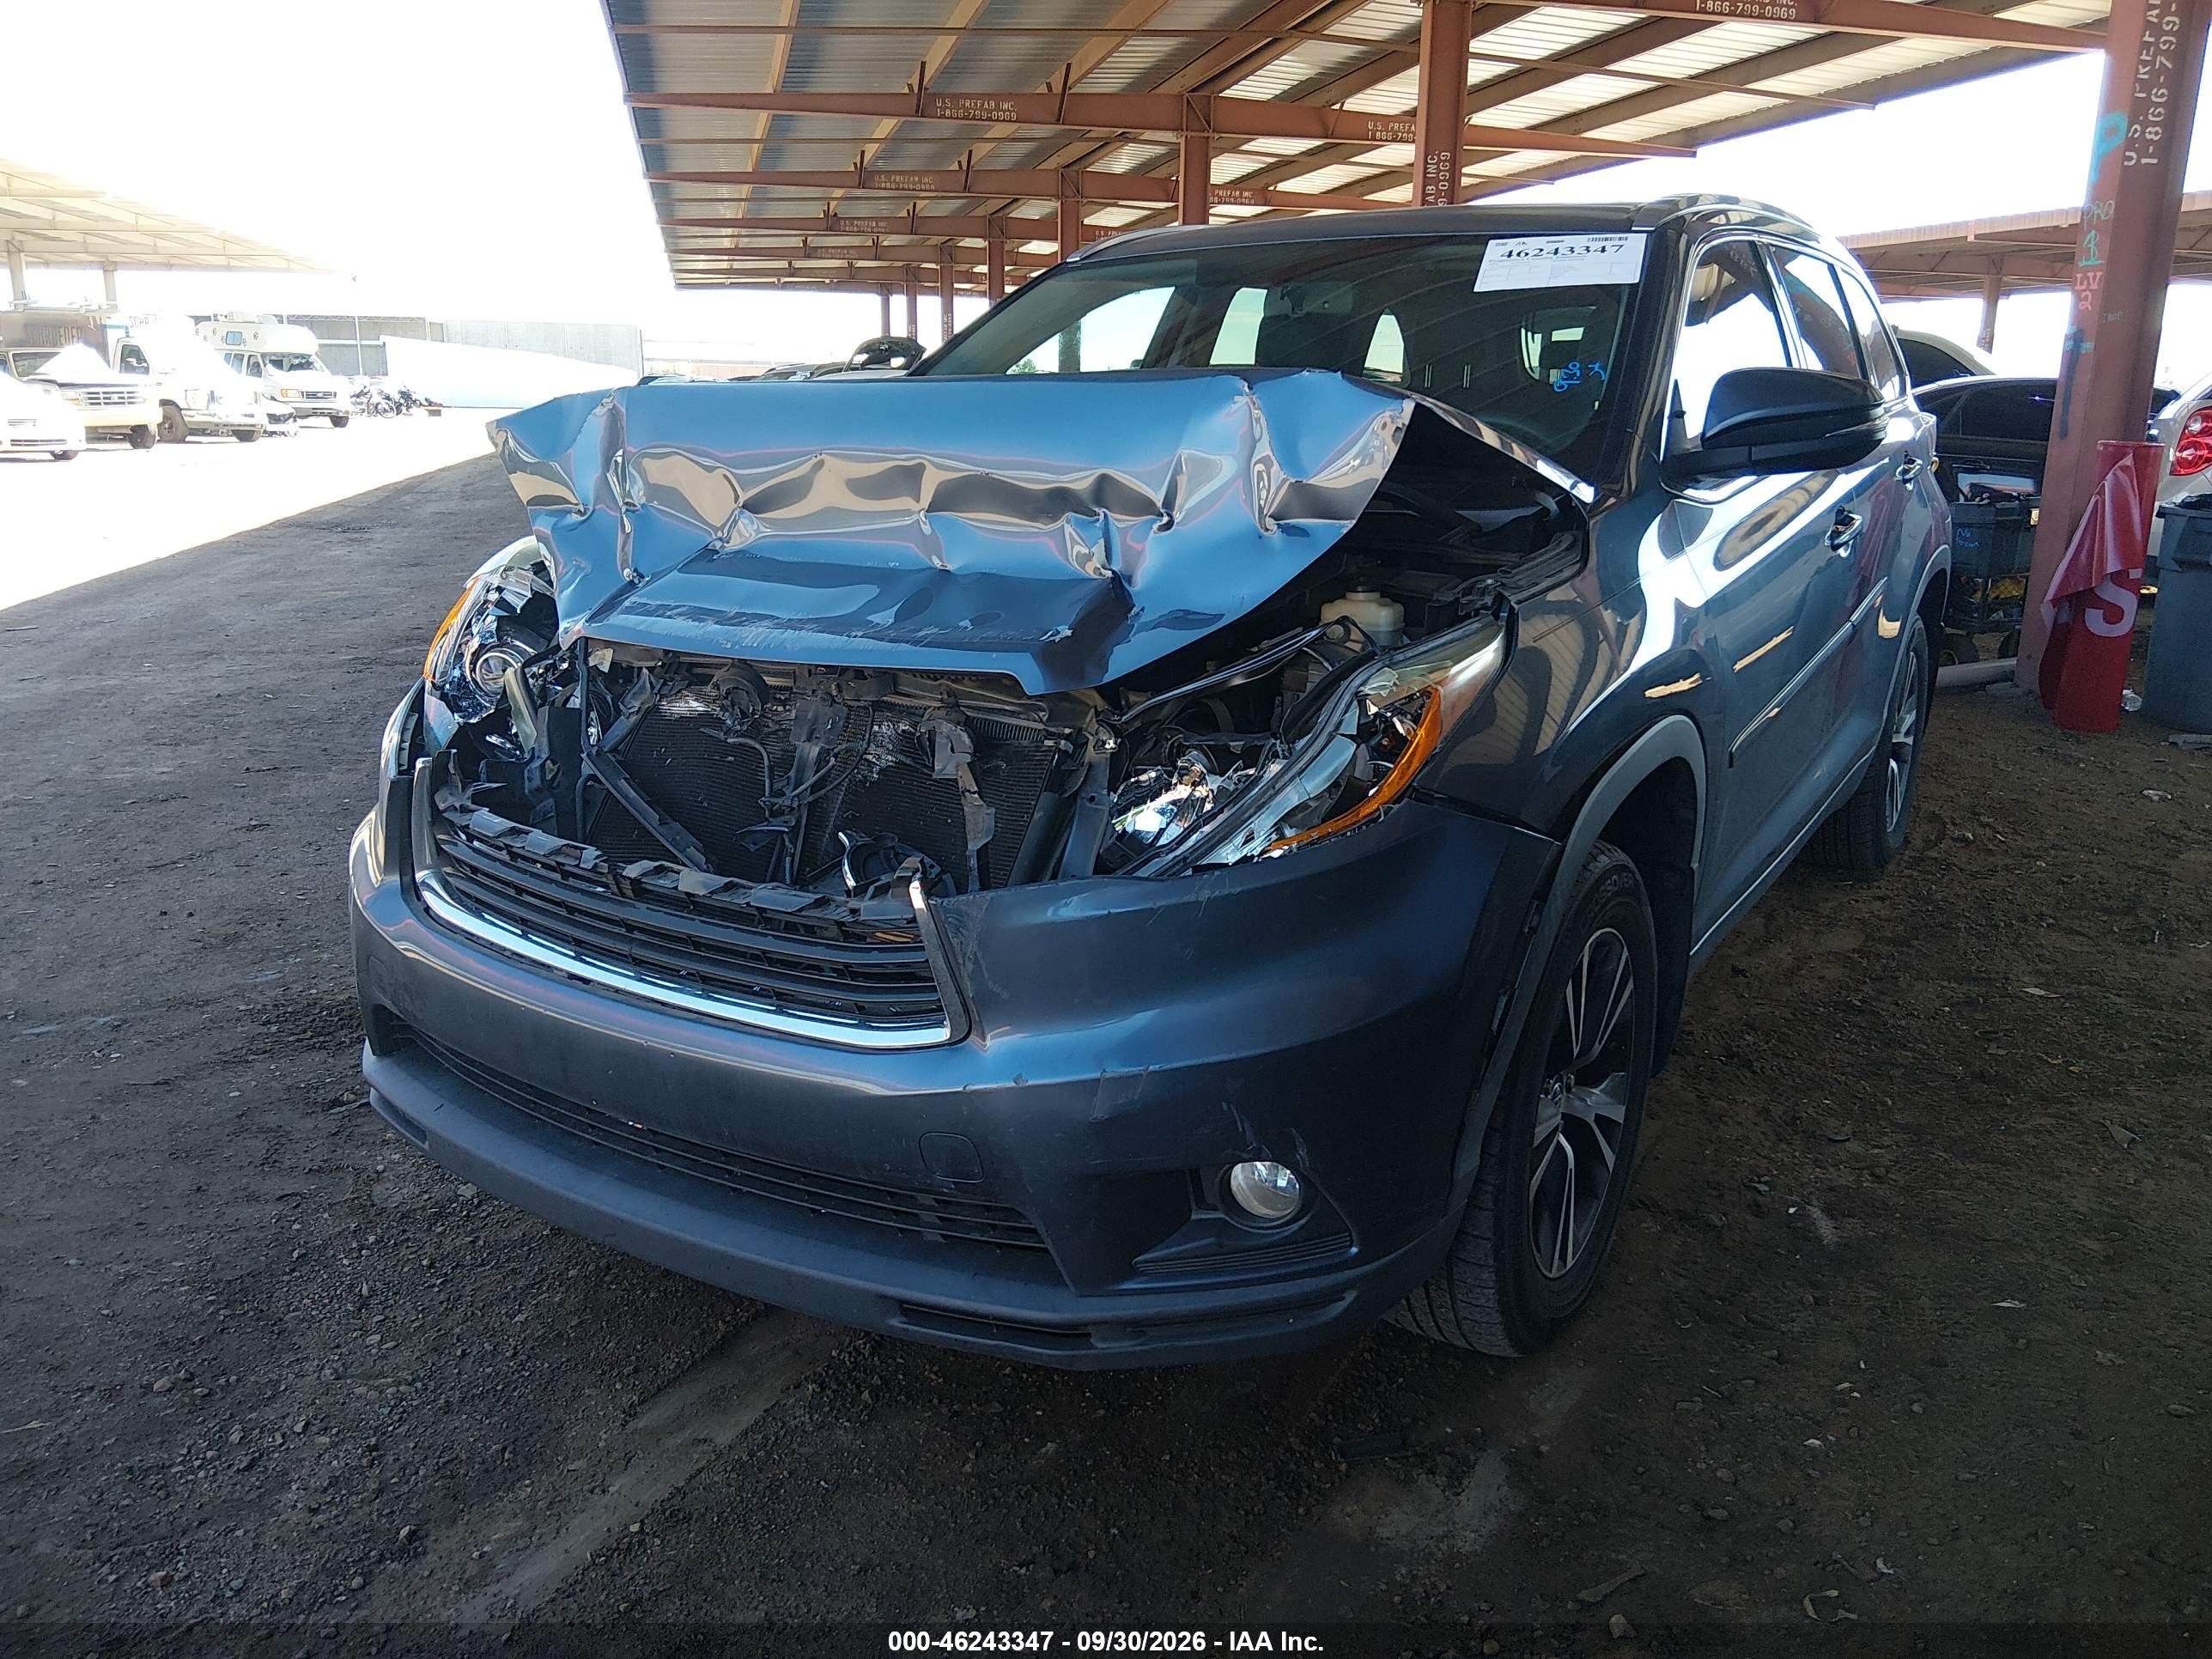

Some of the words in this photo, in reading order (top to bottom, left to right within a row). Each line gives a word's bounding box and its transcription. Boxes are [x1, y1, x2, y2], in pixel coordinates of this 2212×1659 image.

[1696, 0, 1796, 20] 1-866-799-0969
[2141, 3, 2180, 165] 1-866-799-
[936, 97, 954, 108] U.S.
[958, 99, 995, 110] PREFAB
[1000, 100, 1018, 111] INC.
[937, 108, 1017, 121] 1-866-799-0969
[1368, 120, 1385, 131] U.S.
[1368, 131, 1416, 142] 1866-799-
[1499, 244, 1626, 259] 46243347
[2078, 290, 2093, 310] 2
